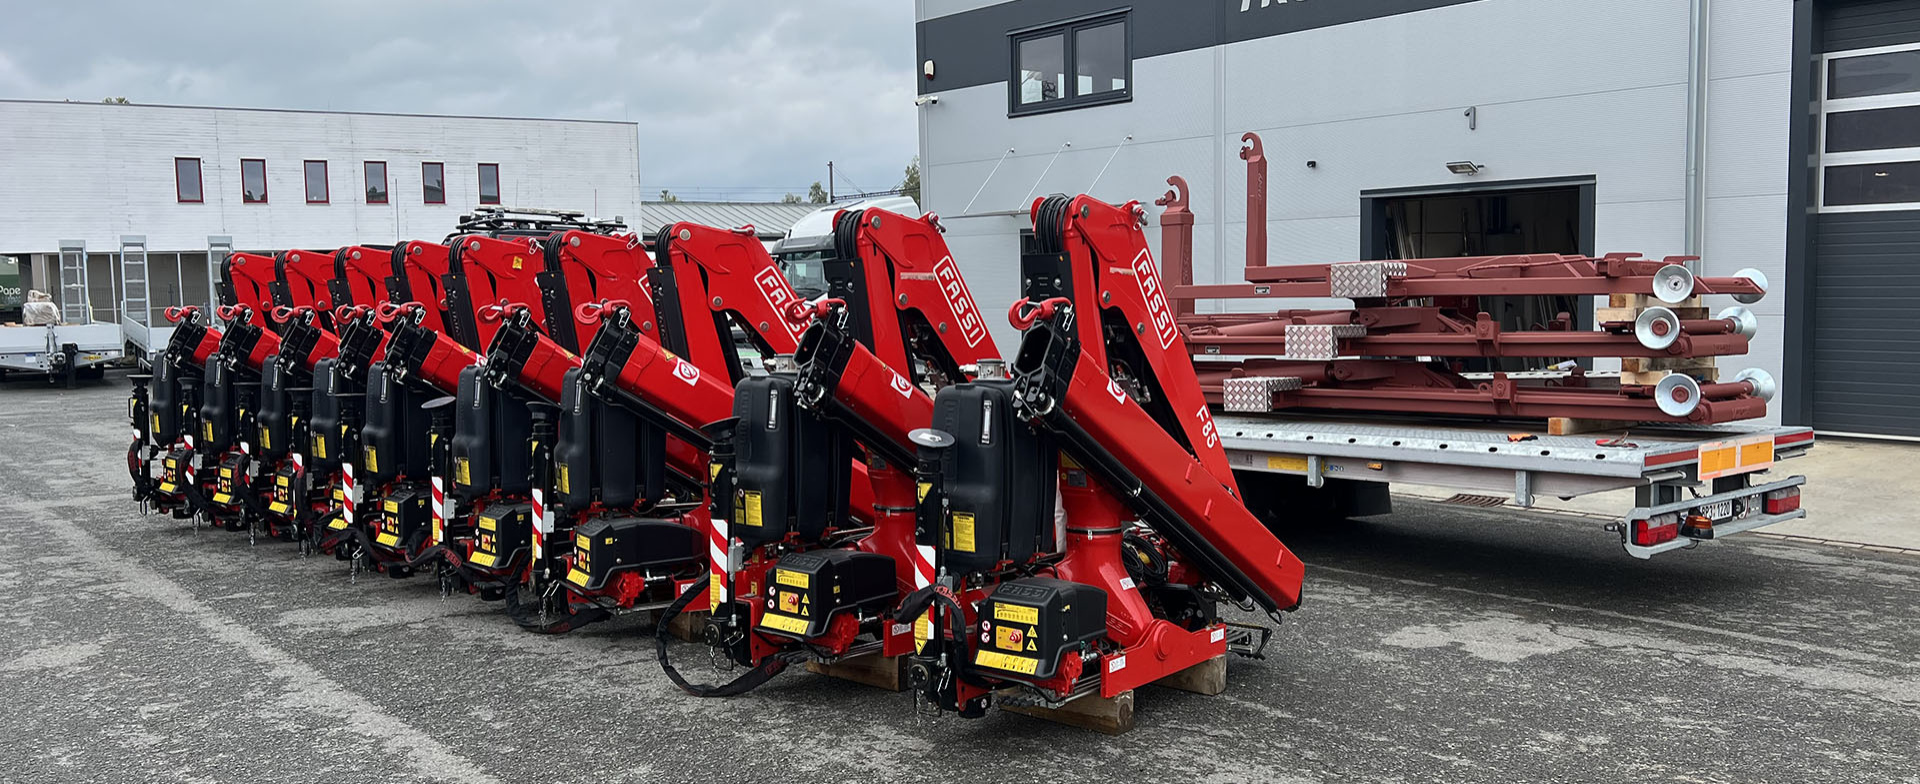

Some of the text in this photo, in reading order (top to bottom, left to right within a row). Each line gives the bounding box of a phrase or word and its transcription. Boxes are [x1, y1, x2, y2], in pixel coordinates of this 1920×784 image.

[1463, 106, 1477, 130] 1
[939, 265, 981, 339] FASSI
[1136, 258, 1173, 340] FASSI
[1195, 404, 1218, 449] F85
